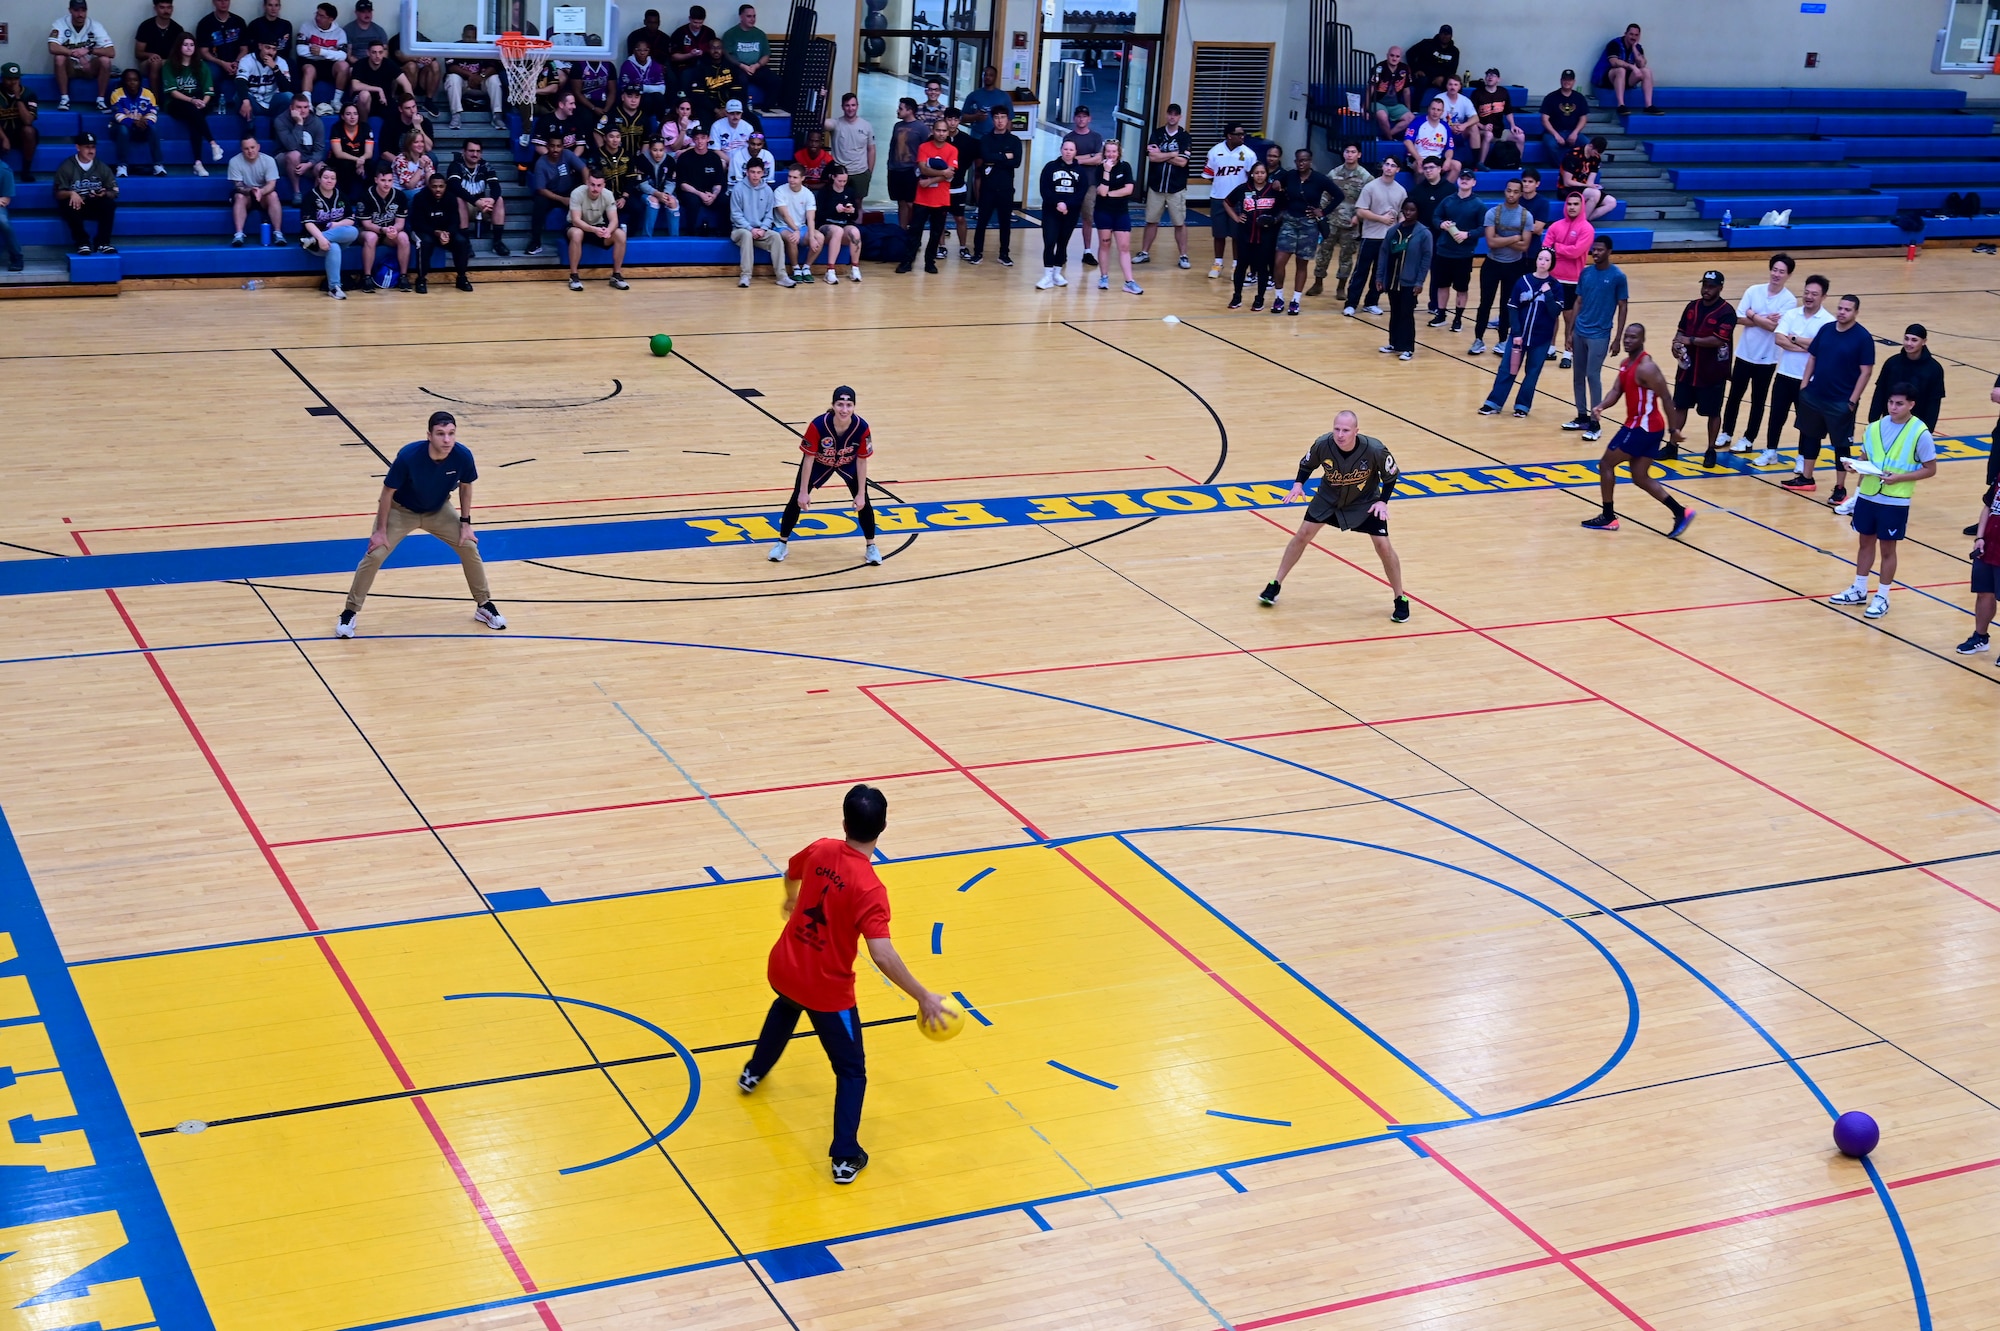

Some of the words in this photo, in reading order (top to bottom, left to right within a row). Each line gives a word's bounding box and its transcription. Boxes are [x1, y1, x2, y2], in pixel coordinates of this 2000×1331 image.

[1216, 165, 1244, 177] MPF
[1026, 483, 1318, 521] WOLF
[685, 502, 1008, 543] PACK
[815, 867, 845, 891] CHECK
